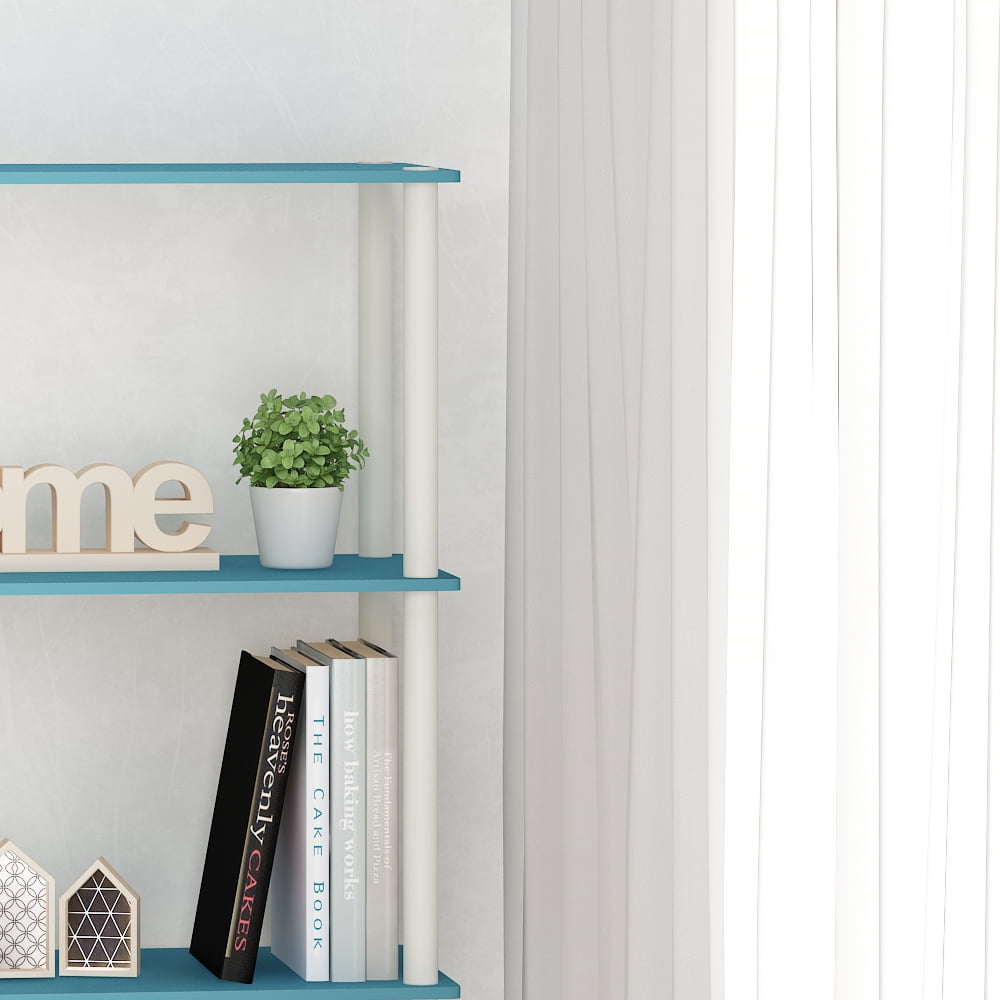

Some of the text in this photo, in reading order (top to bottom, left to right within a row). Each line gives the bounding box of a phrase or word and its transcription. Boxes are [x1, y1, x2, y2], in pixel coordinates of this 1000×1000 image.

[277, 712, 294, 774] ROSE'S
[234, 693, 294, 952] heavenly CAKES
[313, 715, 325, 950] THE CAKE BOOK
[339, 709, 359, 901] how baking works
[373, 795, 382, 827] Bread
[373, 830, 382, 851] and
[384, 752, 392, 871] The Fundamentals of
[373, 855, 382, 884] Pizza
